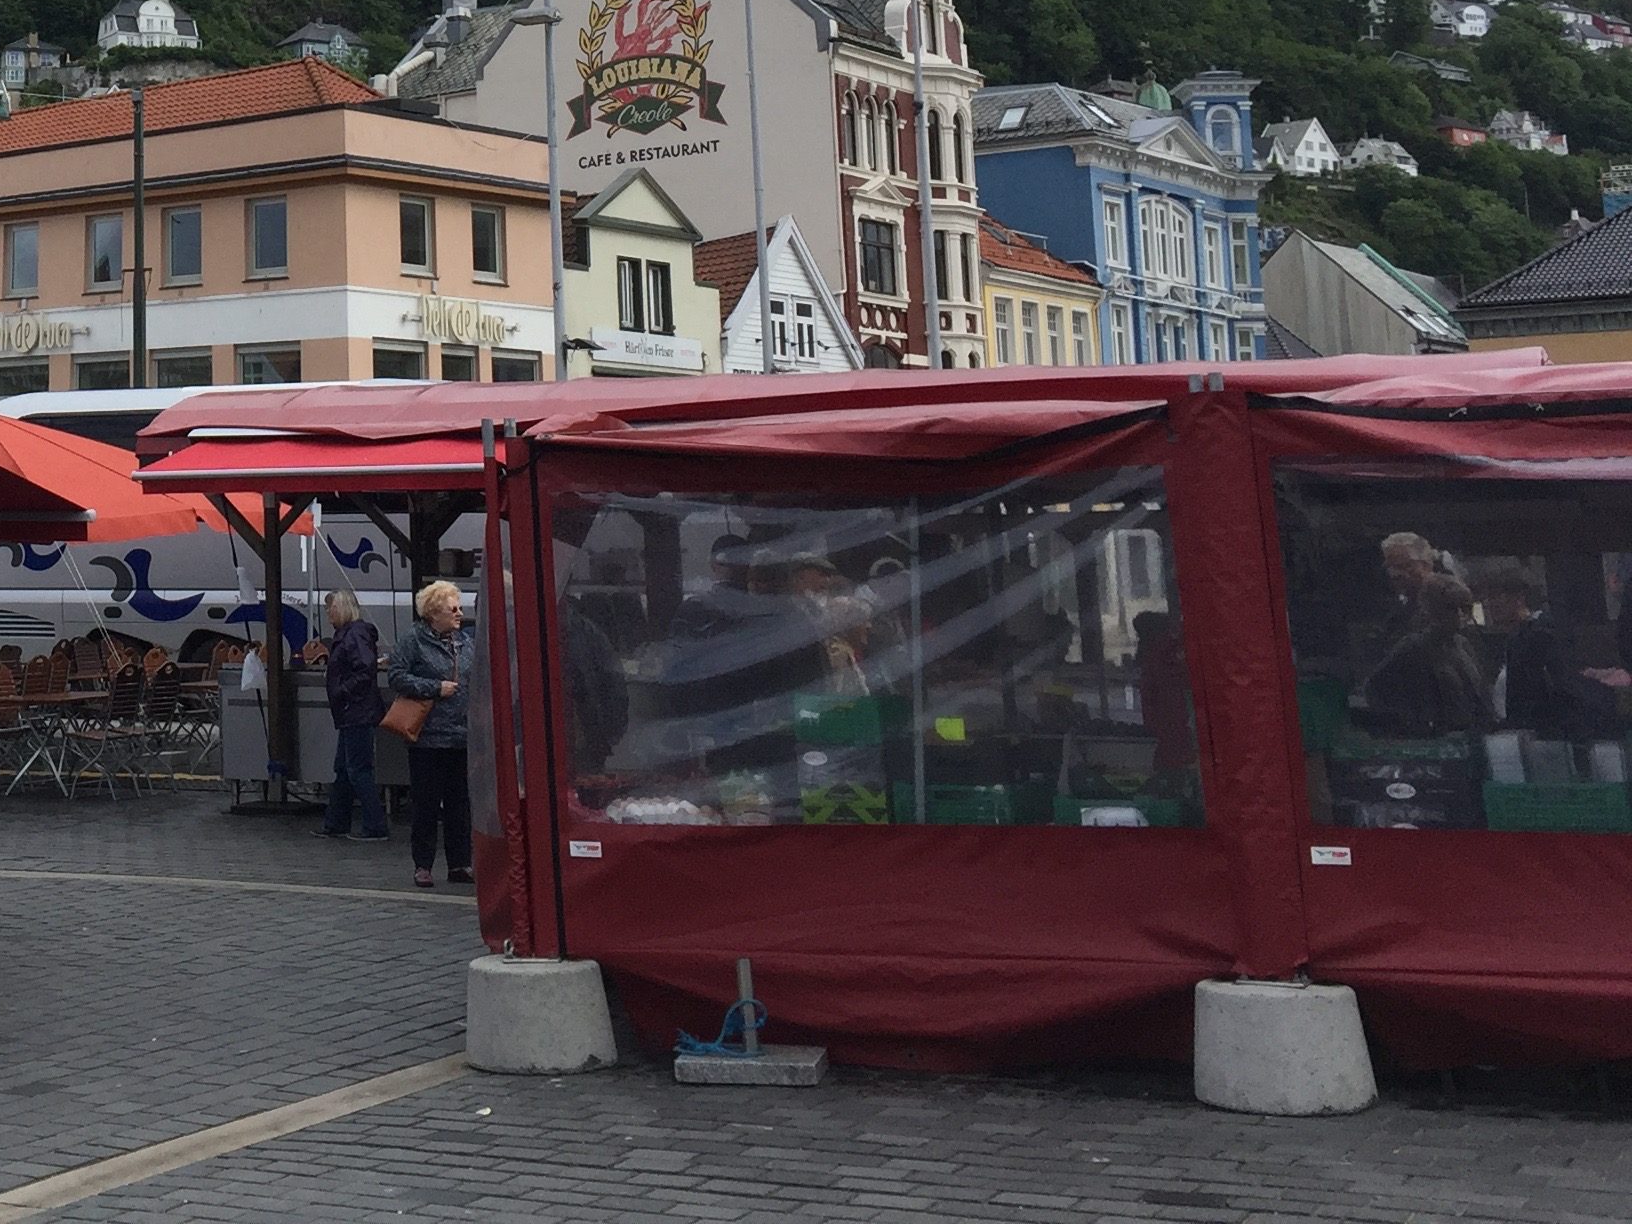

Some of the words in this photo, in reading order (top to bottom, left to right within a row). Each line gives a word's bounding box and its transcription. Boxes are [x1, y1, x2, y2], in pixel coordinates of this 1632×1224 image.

[588, 57, 702, 97] LOUISIANA
[618, 101, 673, 126] Creole
[615, 151, 626, 165] &
[630, 139, 720, 163] RESTAURANT
[13, 316, 37, 352] de
[451, 300, 475, 341] de
